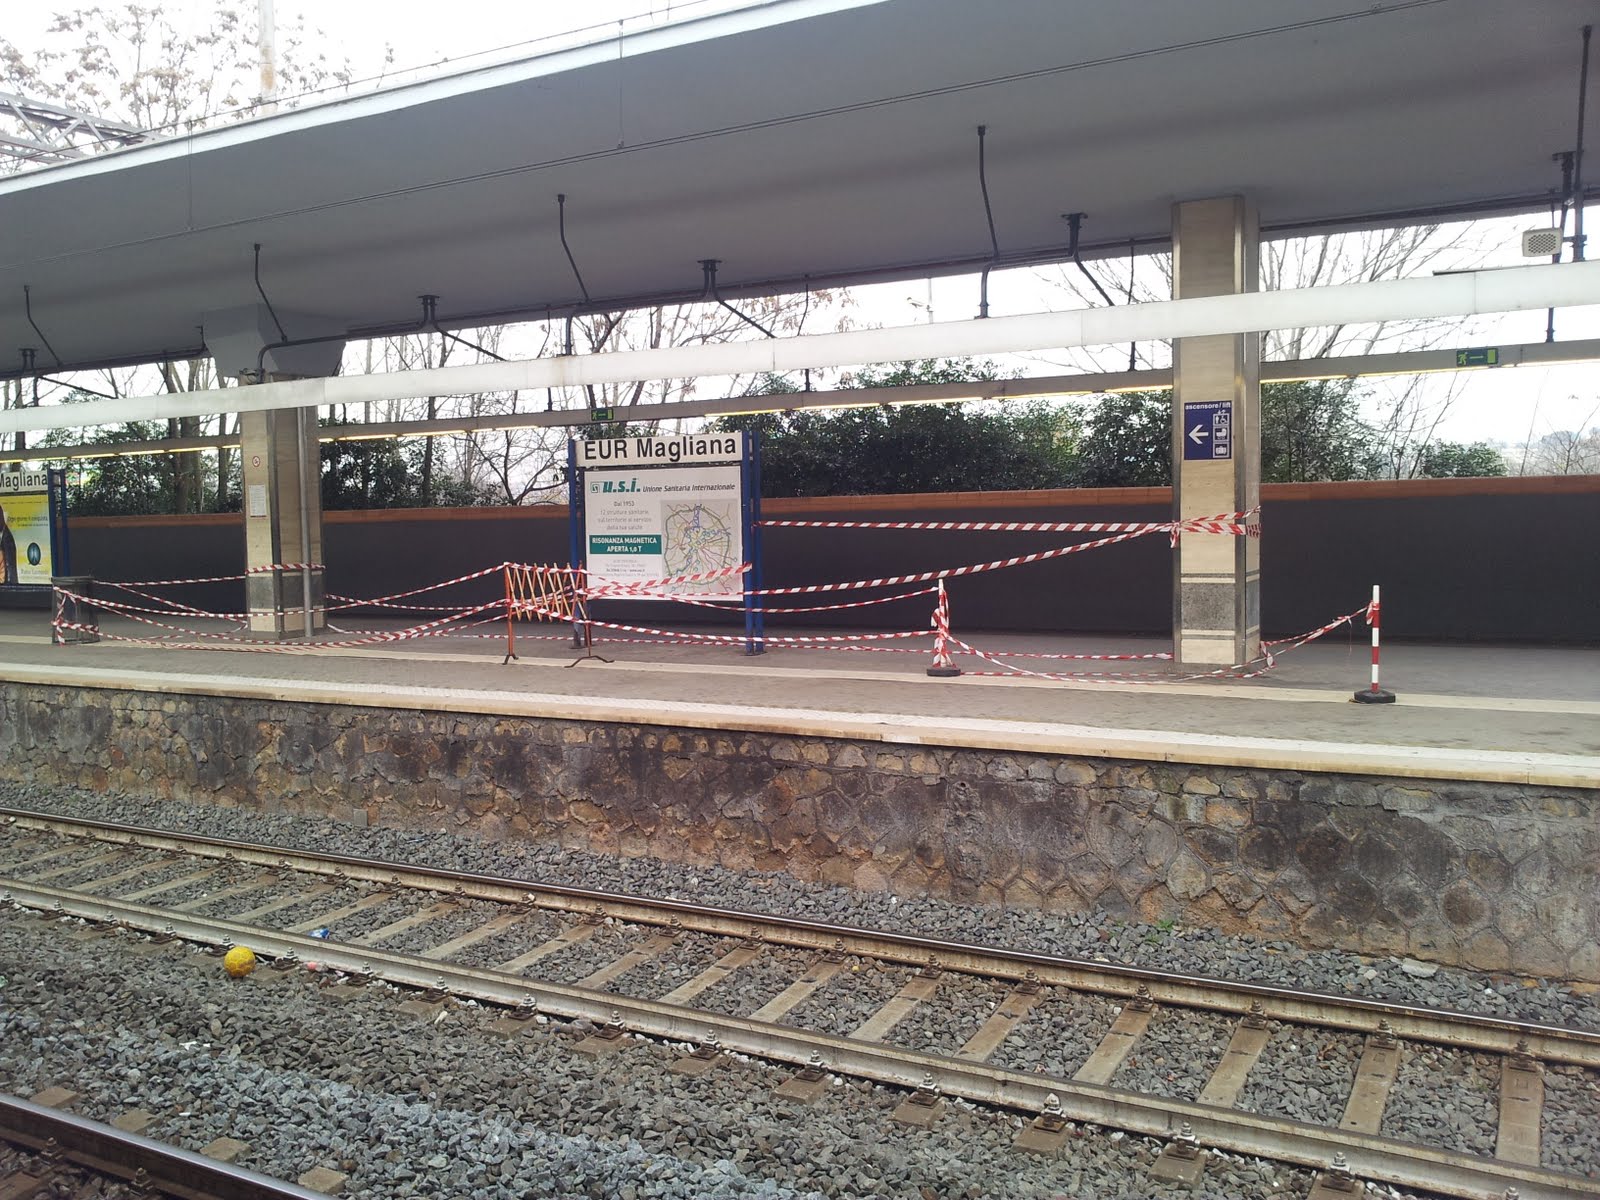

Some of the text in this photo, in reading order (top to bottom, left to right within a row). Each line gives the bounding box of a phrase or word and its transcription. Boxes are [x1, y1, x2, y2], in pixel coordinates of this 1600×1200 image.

[584, 436, 737, 462] EUR Magliana
[643, 483, 736, 493] Unione Sanitaria Internazionale
